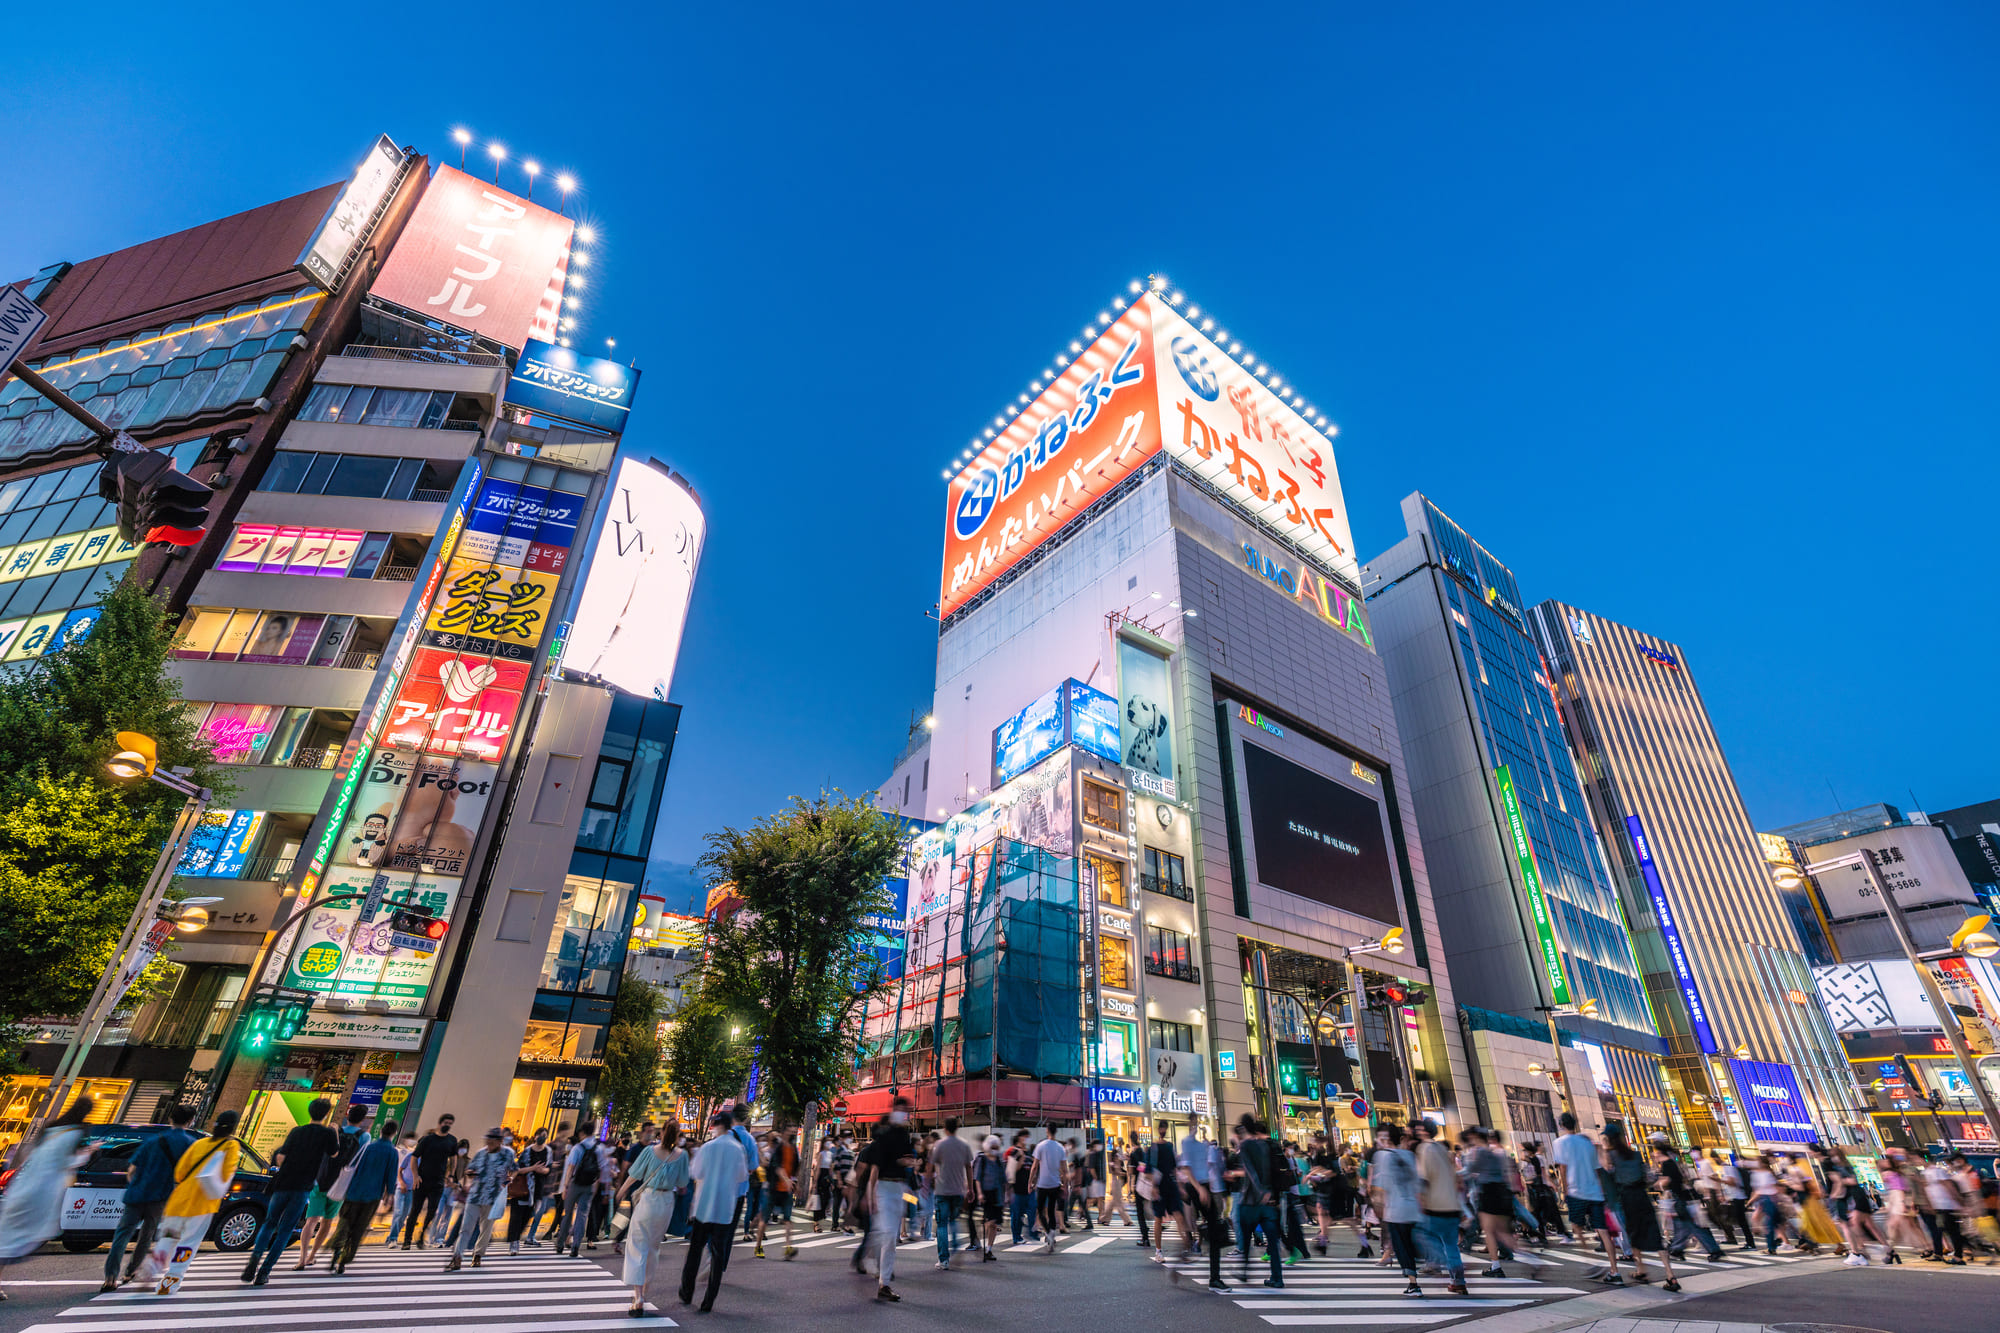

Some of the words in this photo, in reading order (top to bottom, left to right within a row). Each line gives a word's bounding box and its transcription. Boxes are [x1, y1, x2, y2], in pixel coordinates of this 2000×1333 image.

[427, 190, 527, 318] アイフル
[522, 363, 625, 399] アパマンショップ
[1000, 330, 1144, 502] かねふく
[1176, 397, 1342, 557] かねふく
[486, 495, 571, 520] アパマンショップ
[950, 411, 1145, 593] めんたいパーク
[1243, 542, 1296, 594] STUDIO
[448, 570, 546, 608] ダーツ
[1296, 566, 1372, 646] ALTA
[438, 600, 541, 638] グッズ
[446, 634, 483, 652] Darts
[394, 701, 510, 738] アイフル
[1239, 704, 1266, 730] ALTA
[212, 733, 250, 752] Smile
[368, 767, 410, 787] Dr.
[418, 772, 490, 796] Foot
[1288, 821, 1320, 841] ただいま
[213, 814, 250, 874] セントラル
[923, 848, 941, 863] Shop
[1105, 913, 1131, 931] Cafe
[305, 948, 340, 964] 買取
[300, 962, 336, 973] SHOP
[344, 966, 380, 975] ダイヤモンド
[1108, 998, 1134, 1016] Shop
[1933, 1038, 1955, 1051] AB
[289, 1055, 318, 1065] アイフル
[537, 1054, 563, 1064] CROSS
[566, 1056, 604, 1067] SHINJUKU
[1106, 1089, 1134, 1104] TAPI
[1750, 1083, 1789, 1100] MIZUHO
[1638, 1103, 1662, 1120] GUCCI
[1961, 1122, 1990, 1139] AB
